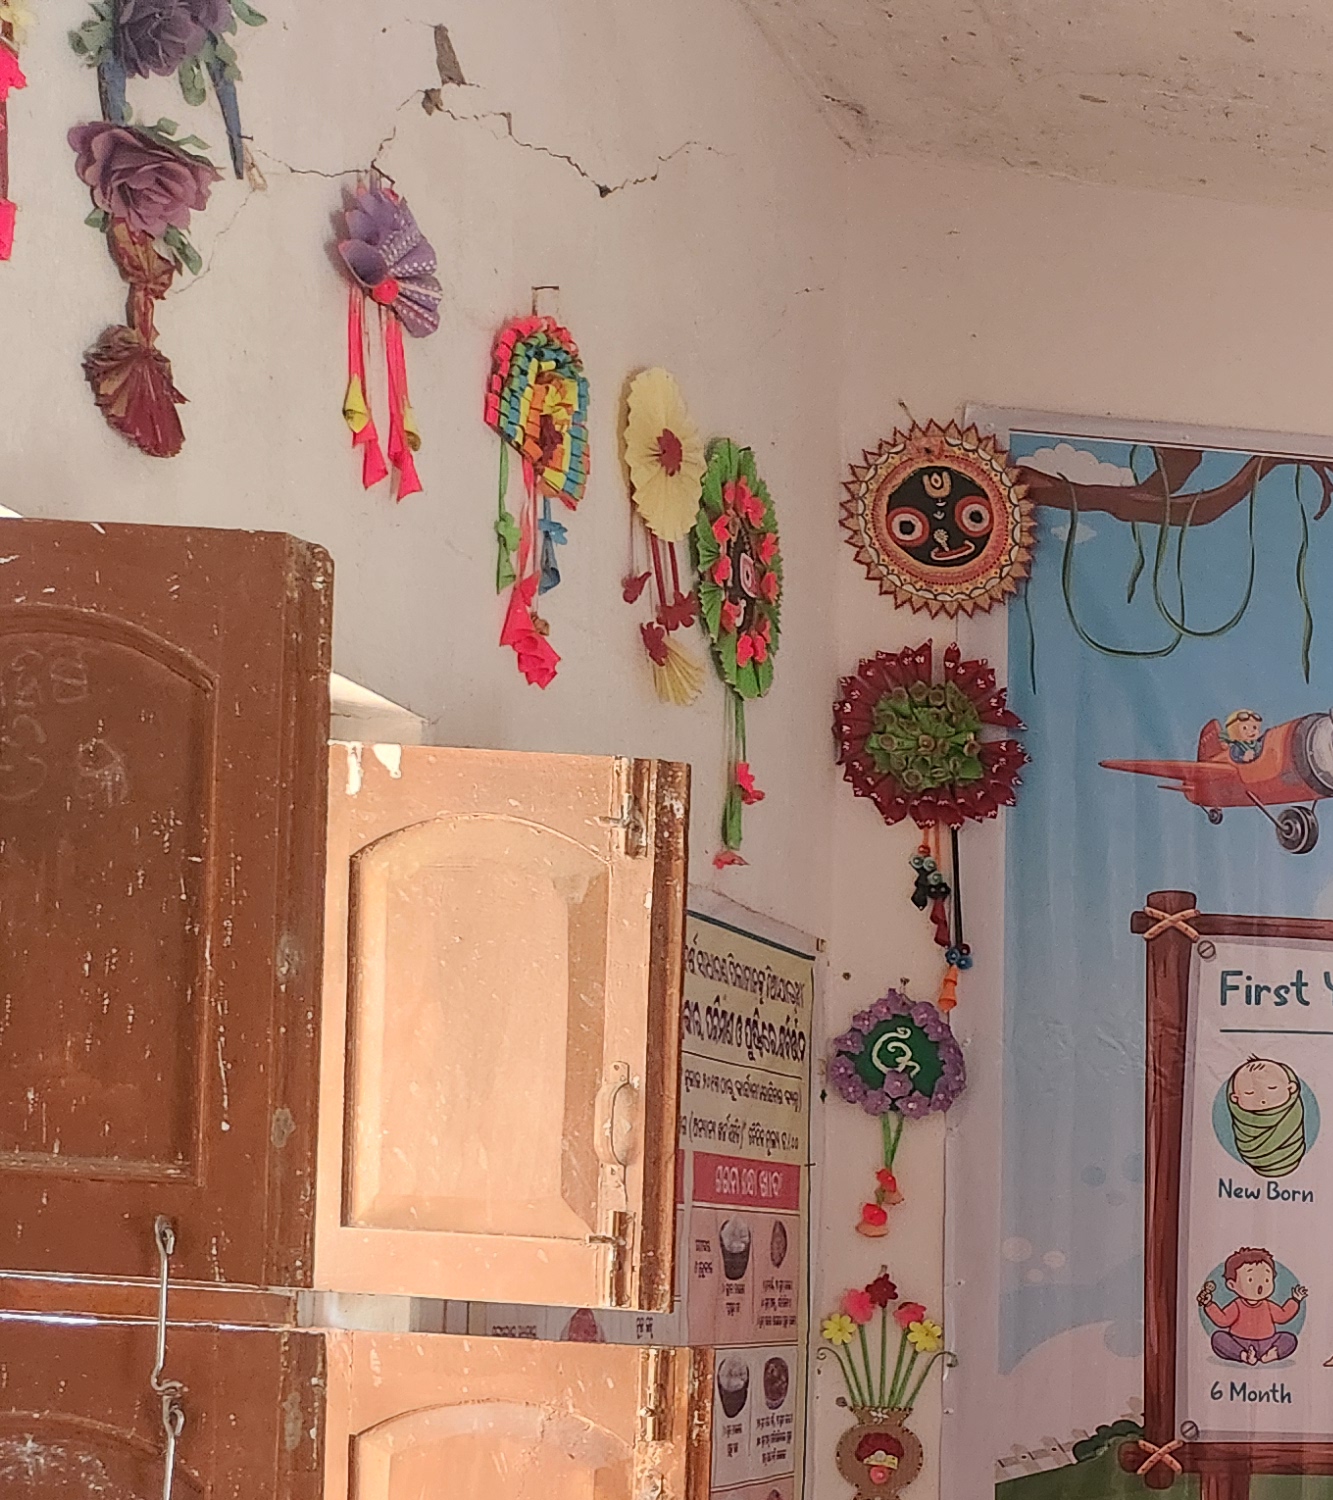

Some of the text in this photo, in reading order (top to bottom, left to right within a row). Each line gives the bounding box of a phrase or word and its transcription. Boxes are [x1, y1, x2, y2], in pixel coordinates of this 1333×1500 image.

[1218, 968, 1310, 1010] First
[1218, 1178, 1315, 1206] New Born
[1209, 1381, 1293, 1406] 6 Month
